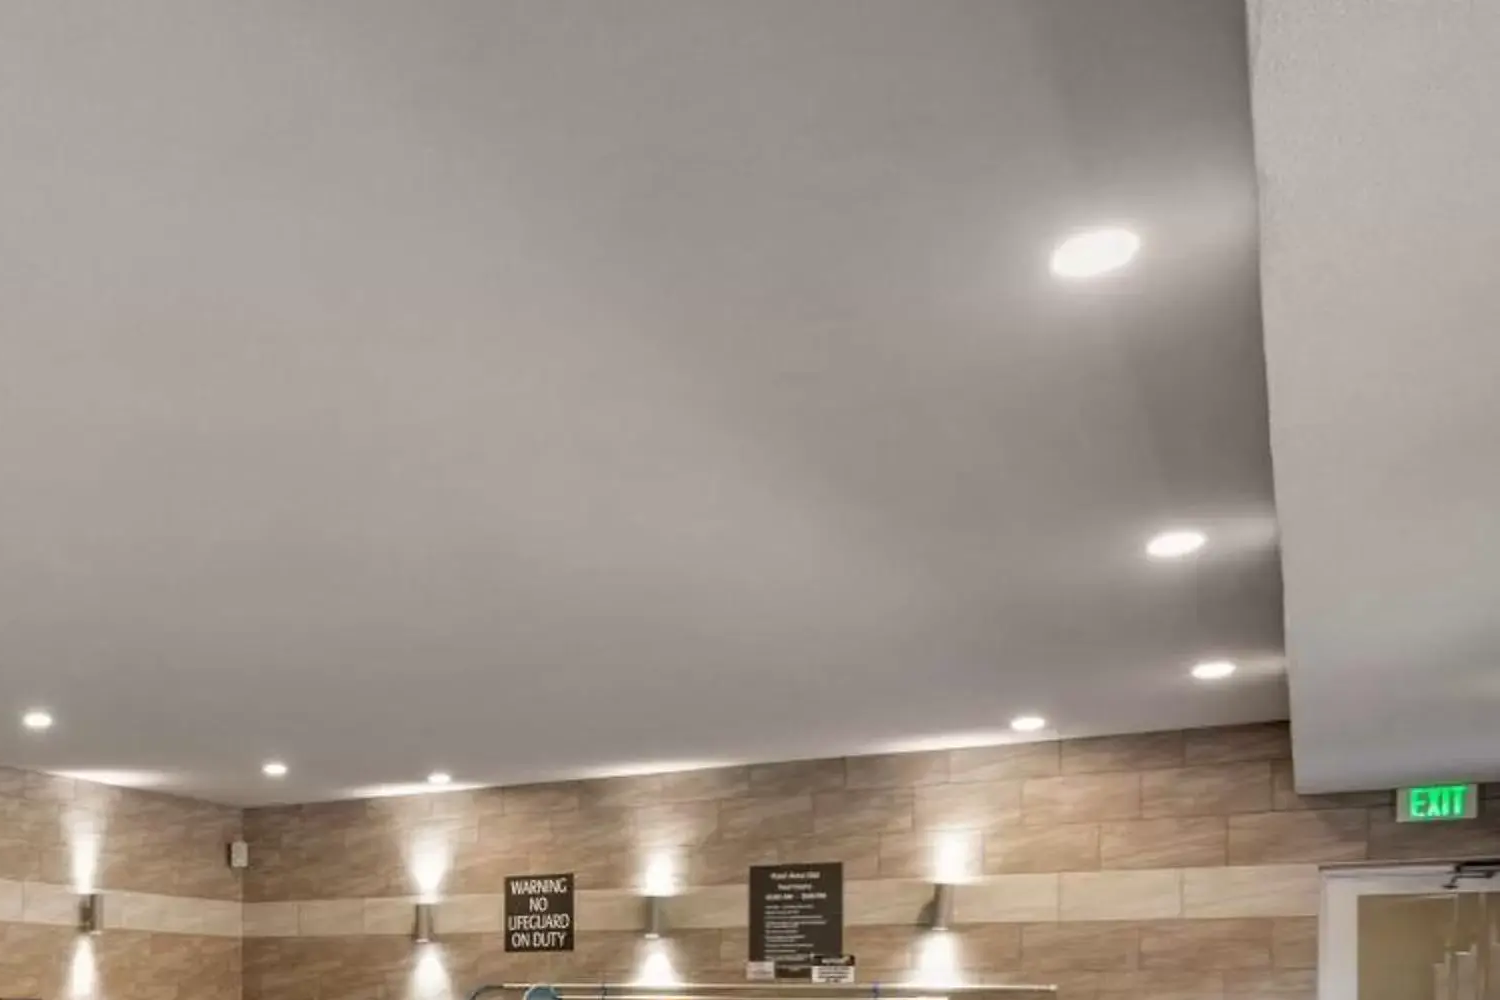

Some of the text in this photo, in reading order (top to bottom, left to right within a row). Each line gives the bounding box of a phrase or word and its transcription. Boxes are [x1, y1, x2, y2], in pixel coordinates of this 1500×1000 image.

[1409, 786, 1468, 817] EXIT
[510, 878, 568, 895] WARNING
[529, 896, 549, 912] NO
[508, 913, 571, 931] LIFEGUARD
[511, 930, 567, 948] ON DUTY
